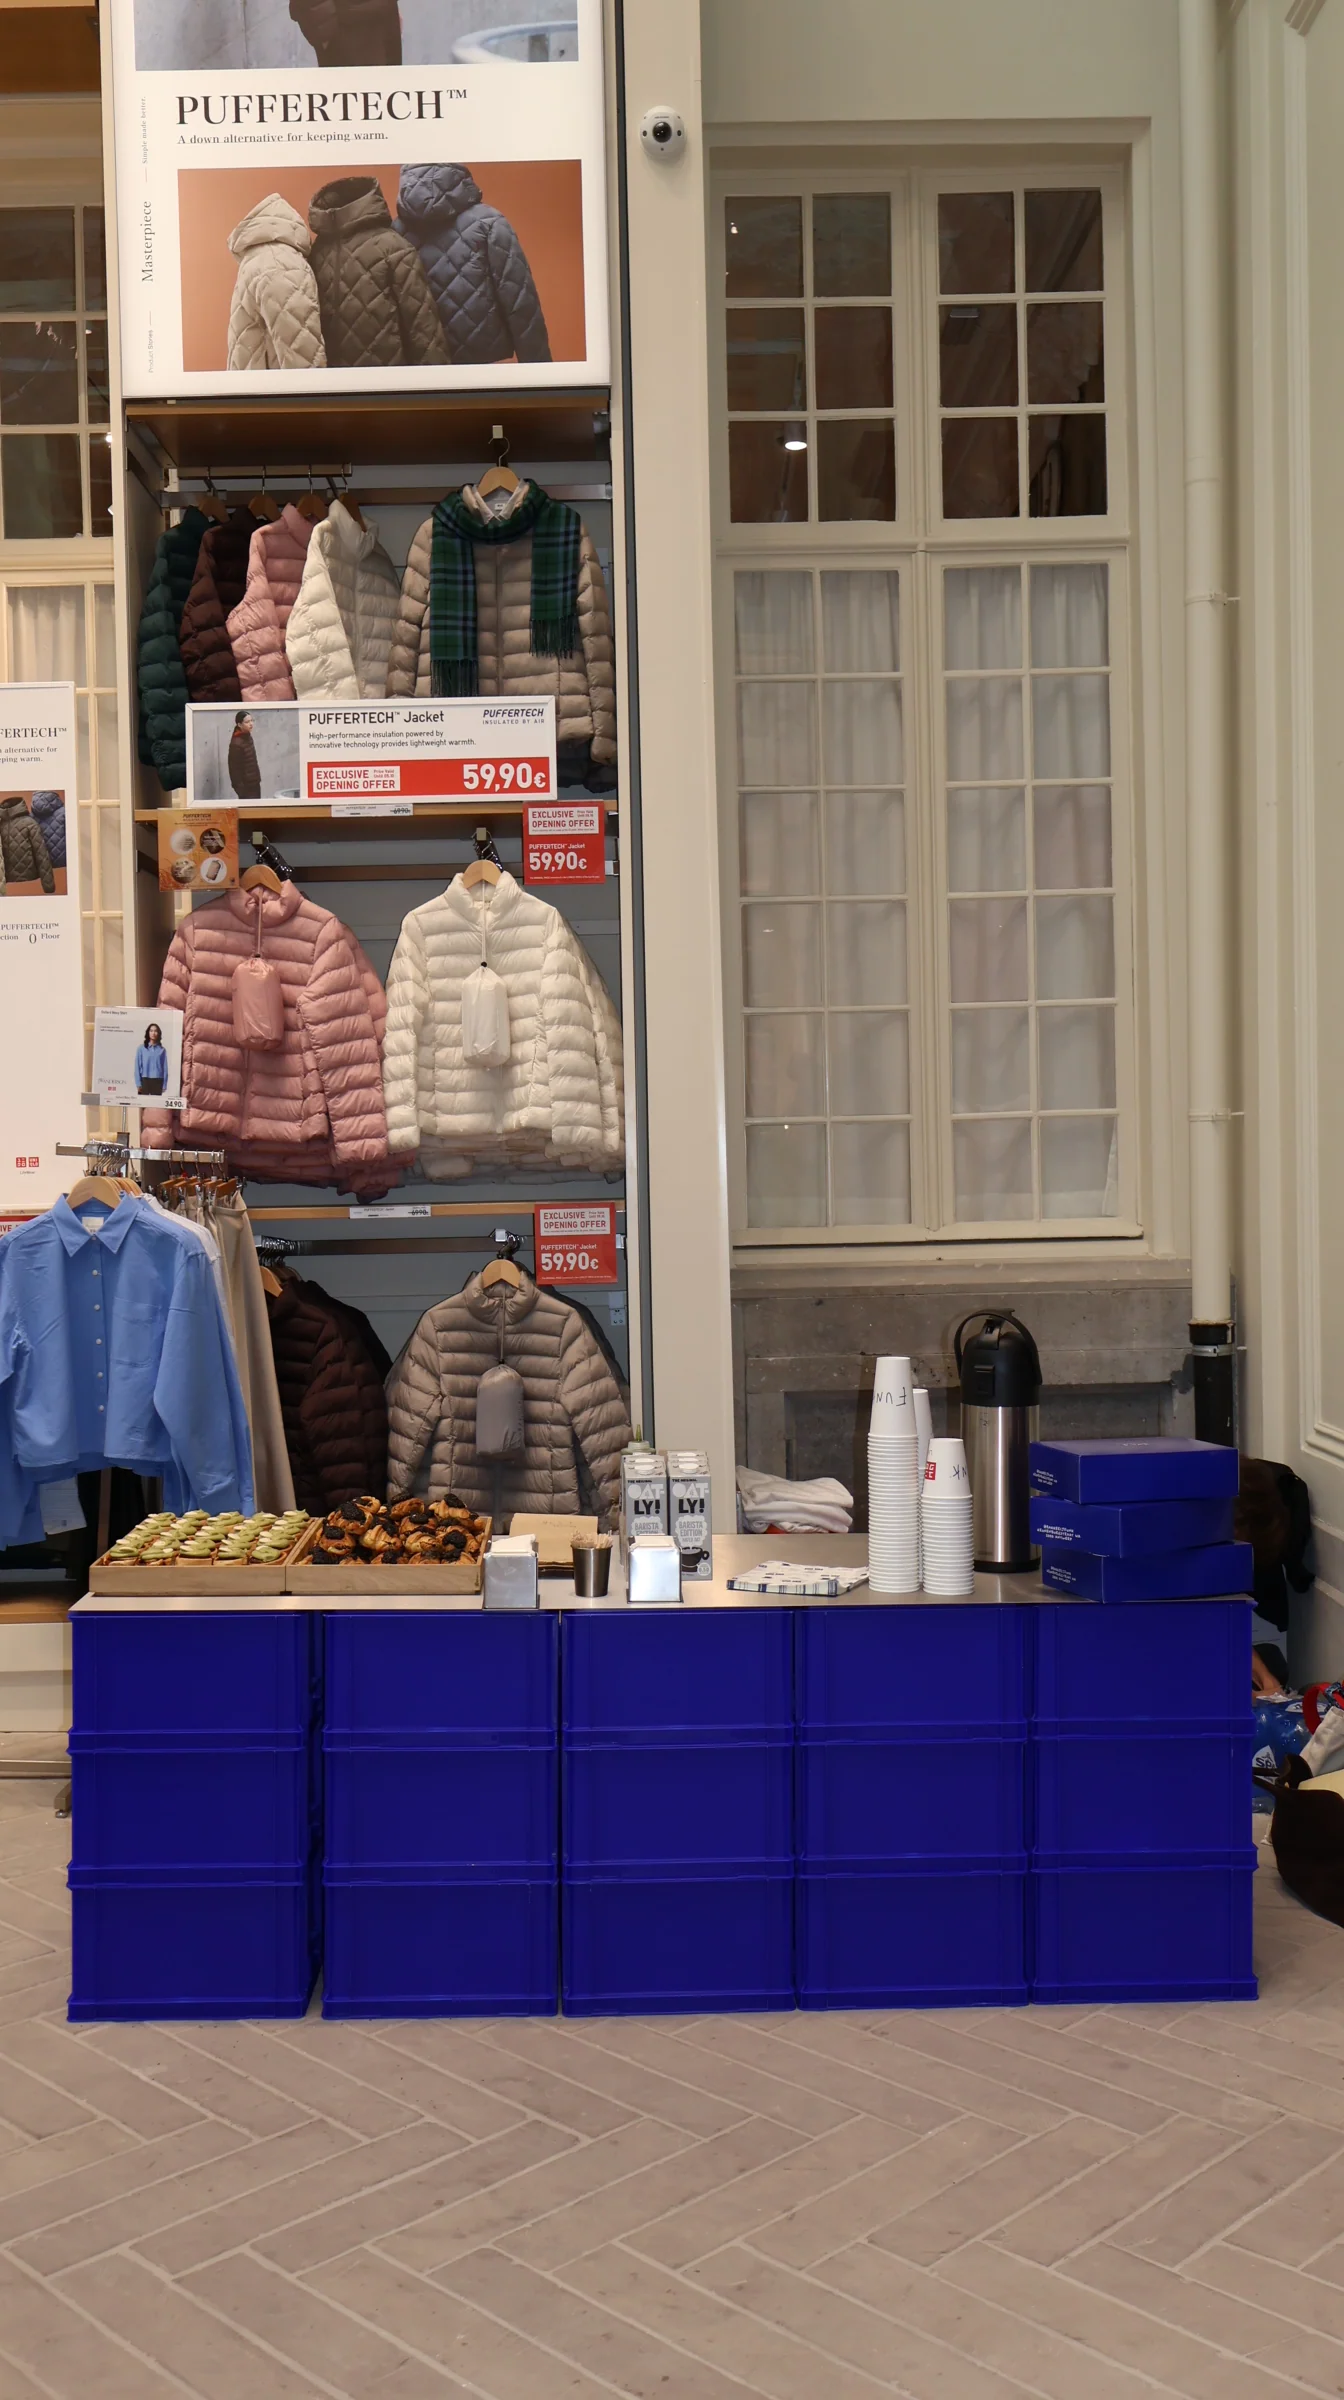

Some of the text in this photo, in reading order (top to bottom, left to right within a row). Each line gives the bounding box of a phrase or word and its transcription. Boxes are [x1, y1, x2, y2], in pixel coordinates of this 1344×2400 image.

[177, 132, 388, 144] A down alternative for keeping warm.
[140, 201, 155, 282] Masterpiece
[404, 711, 444, 723] Jacket
[483, 708, 544, 718] PUFFERTECH
[309, 732, 371, 740] High-performance
[405, 730, 434, 738] powered
[436, 730, 444, 738] by
[343, 741, 379, 749] technology
[381, 740, 409, 748] provides
[410, 739, 447, 748] lightweight
[316, 770, 369, 779] EXCLUSIVE
[463, 762, 546, 792] 59,90€
[316, 780, 395, 790] OPENING OFFER
[532, 811, 574, 819] EXCLUSIVE
[532, 820, 567, 828] OPENING
[529, 851, 588, 873] 59,90€
[41, 932, 60, 940] Floor
[543, 1212, 586, 1220] EXCLUSIVE
[544, 1220, 606, 1229] OPENING OFFER
[541, 1252, 599, 1273] 59,90€
[875, 1387, 906, 1406] FUN
[634, 1499, 661, 1515] LY!
[678, 1498, 705, 1514] LY!
[634, 1522, 659, 1530] BARISTA
[679, 1521, 704, 1529] BARISTA
[680, 1529, 703, 1537] EDITION
